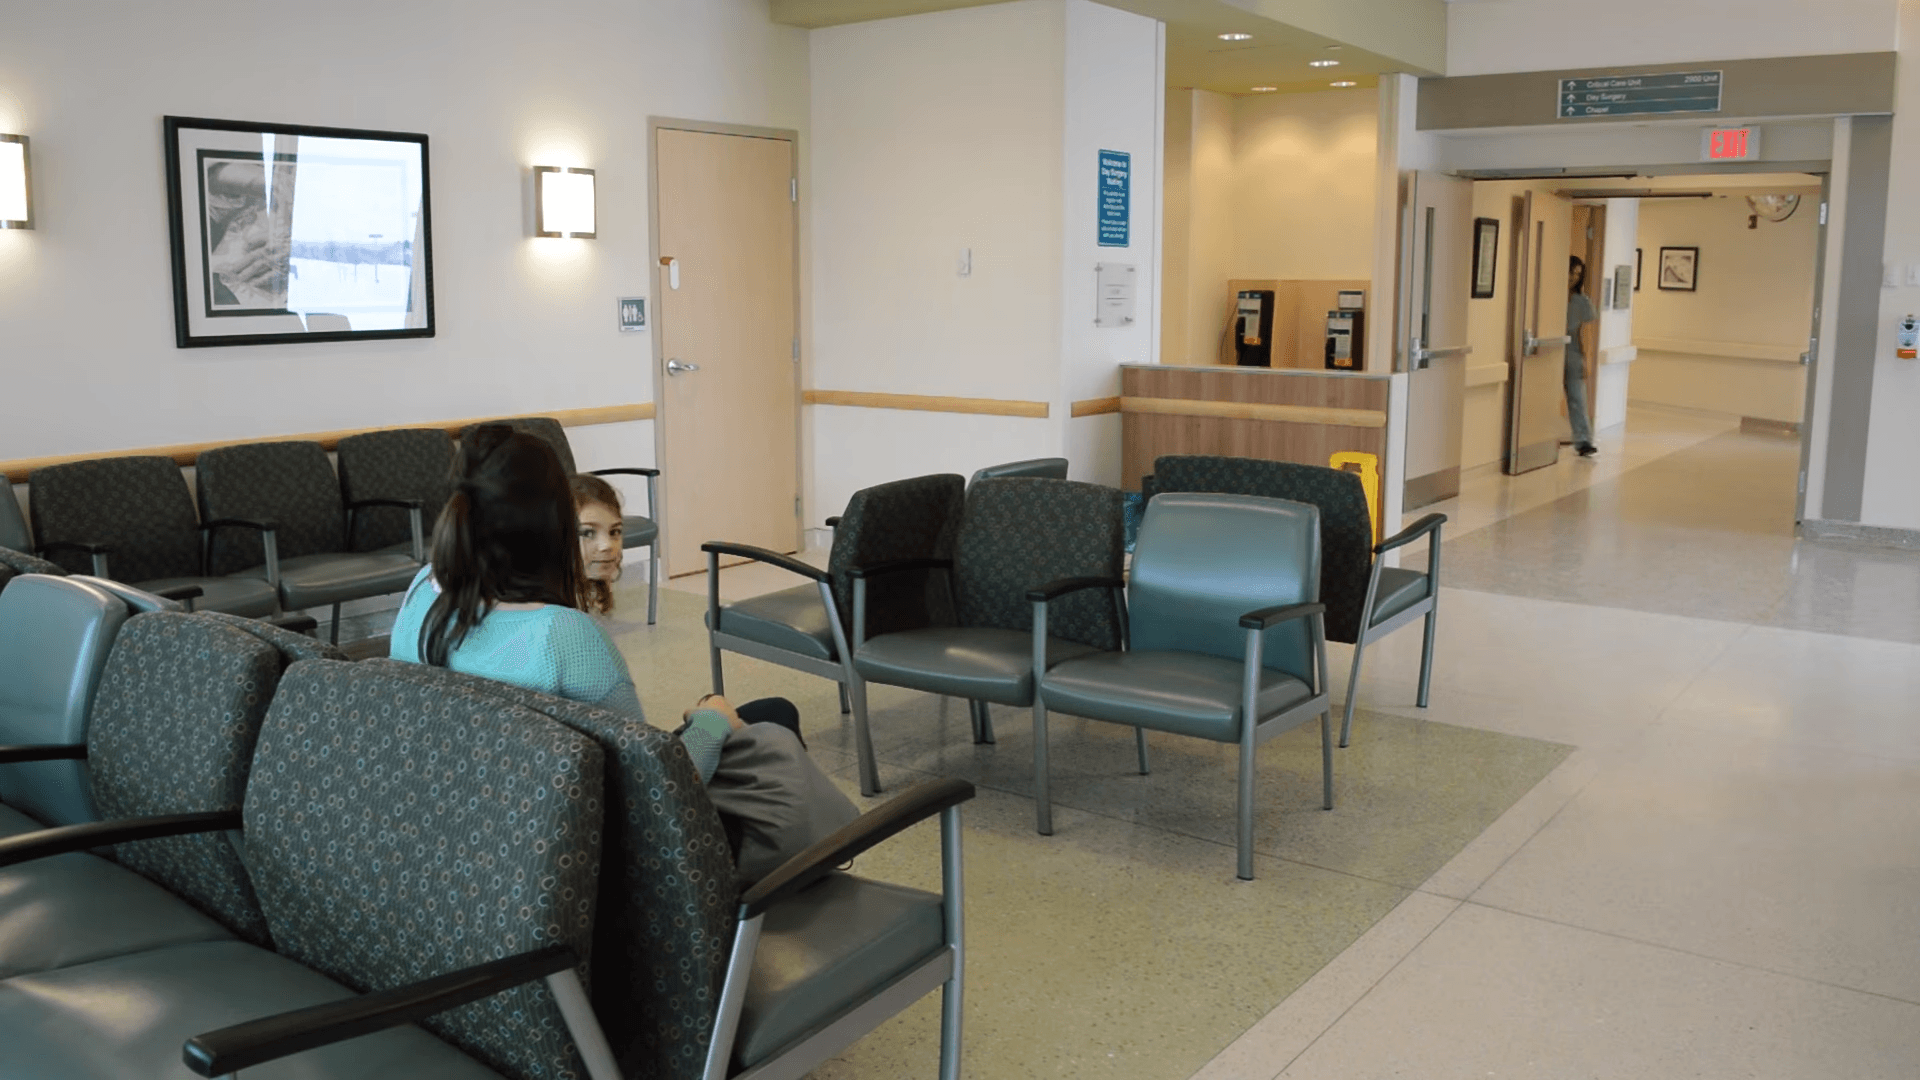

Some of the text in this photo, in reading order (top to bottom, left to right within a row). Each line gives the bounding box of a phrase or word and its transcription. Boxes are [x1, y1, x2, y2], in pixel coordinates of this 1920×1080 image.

[1702, 74, 1718, 82] Unit
[1627, 79, 1642, 87] Unit
[1600, 93, 1627, 102] Surgery
[1585, 106, 1609, 114] Chapel
[1710, 129, 1749, 158] EXIT
[1101, 167, 1127, 179] Day Surgery
